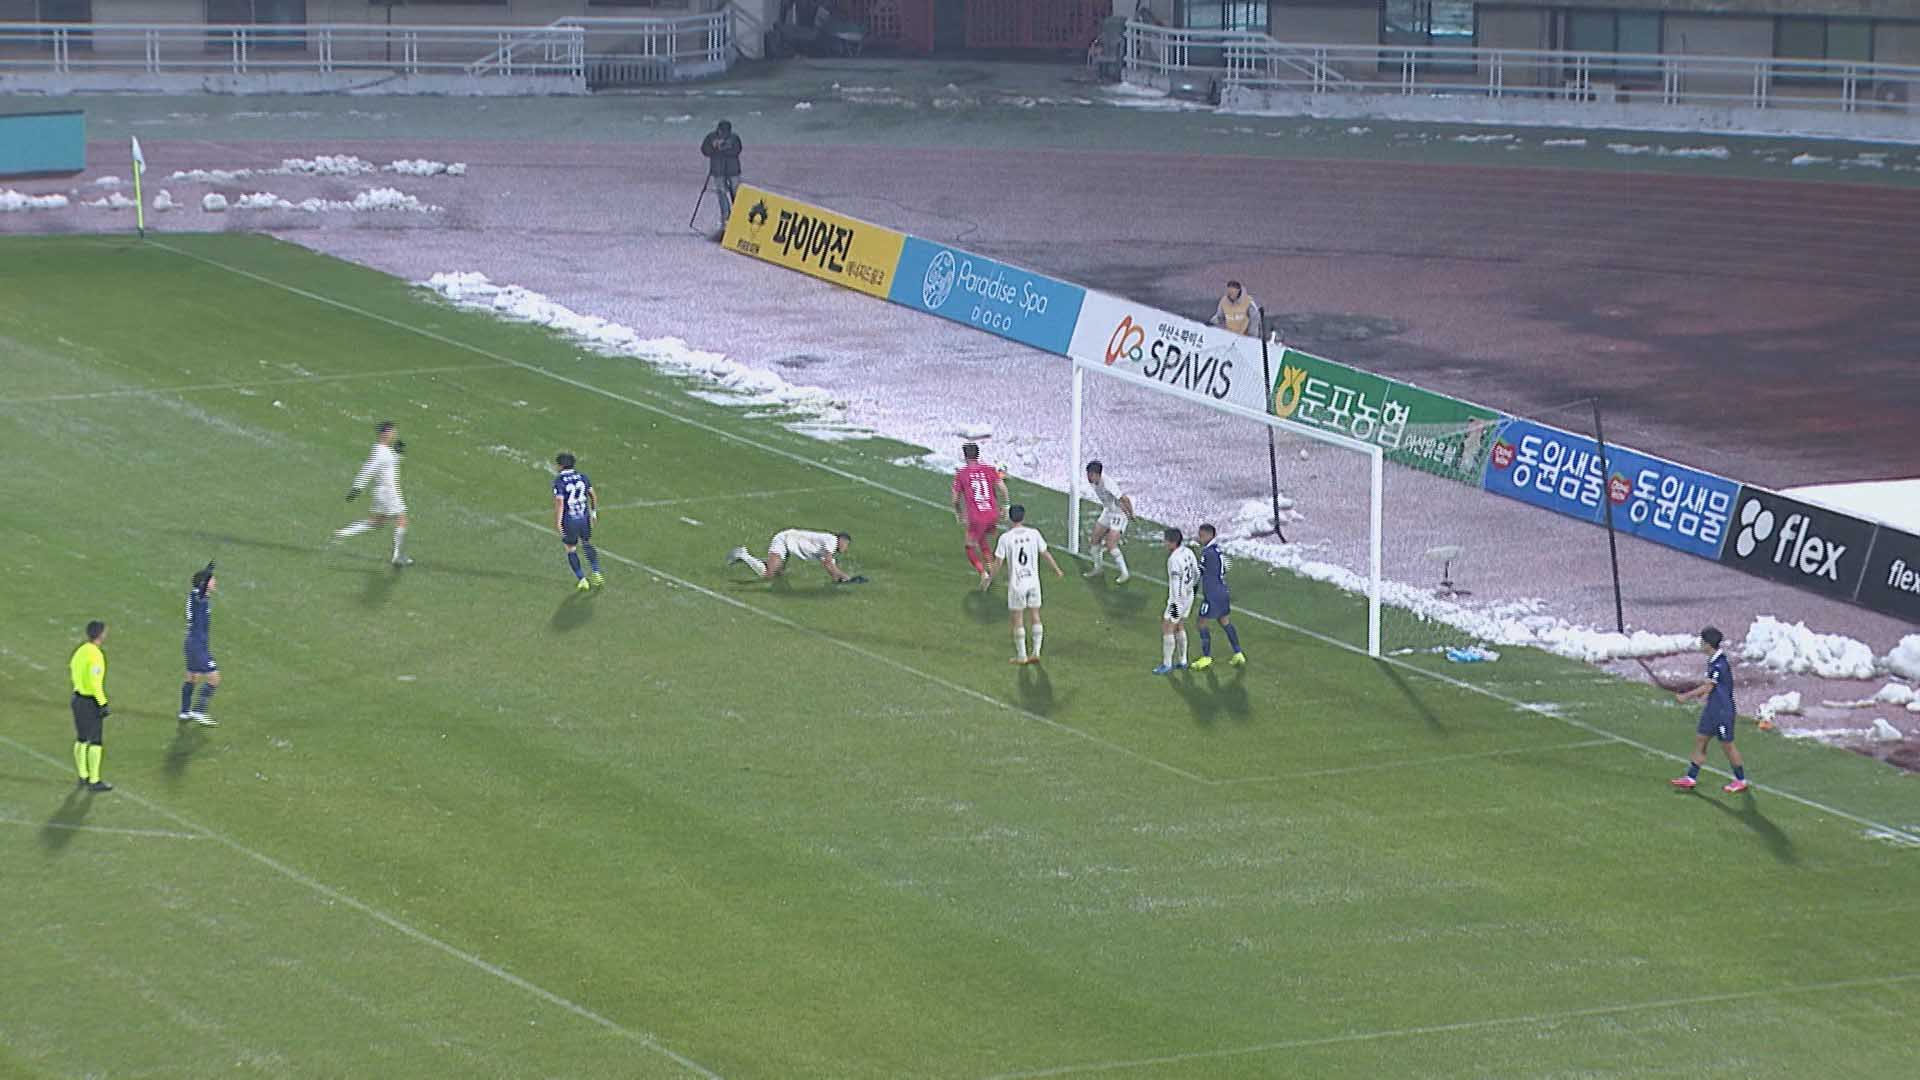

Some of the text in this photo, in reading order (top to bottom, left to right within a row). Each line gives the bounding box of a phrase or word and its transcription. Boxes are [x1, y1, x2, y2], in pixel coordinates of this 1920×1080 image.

[773, 209, 853, 273] 파이어진
[957, 260, 1048, 319] Paradise Spa
[970, 305, 1012, 331] DOGO
[1143, 339, 1233, 400] SPAVIS
[1298, 377, 1410, 448] 둔포농협
[565, 480, 587, 505] 22
[1513, 435, 1610, 508] 동원샘물
[1629, 469, 1730, 545] 동원샘물
[1017, 546, 1029, 567] 6
[1773, 513, 1847, 582] flex
[1887, 559, 1920, 595] flex
